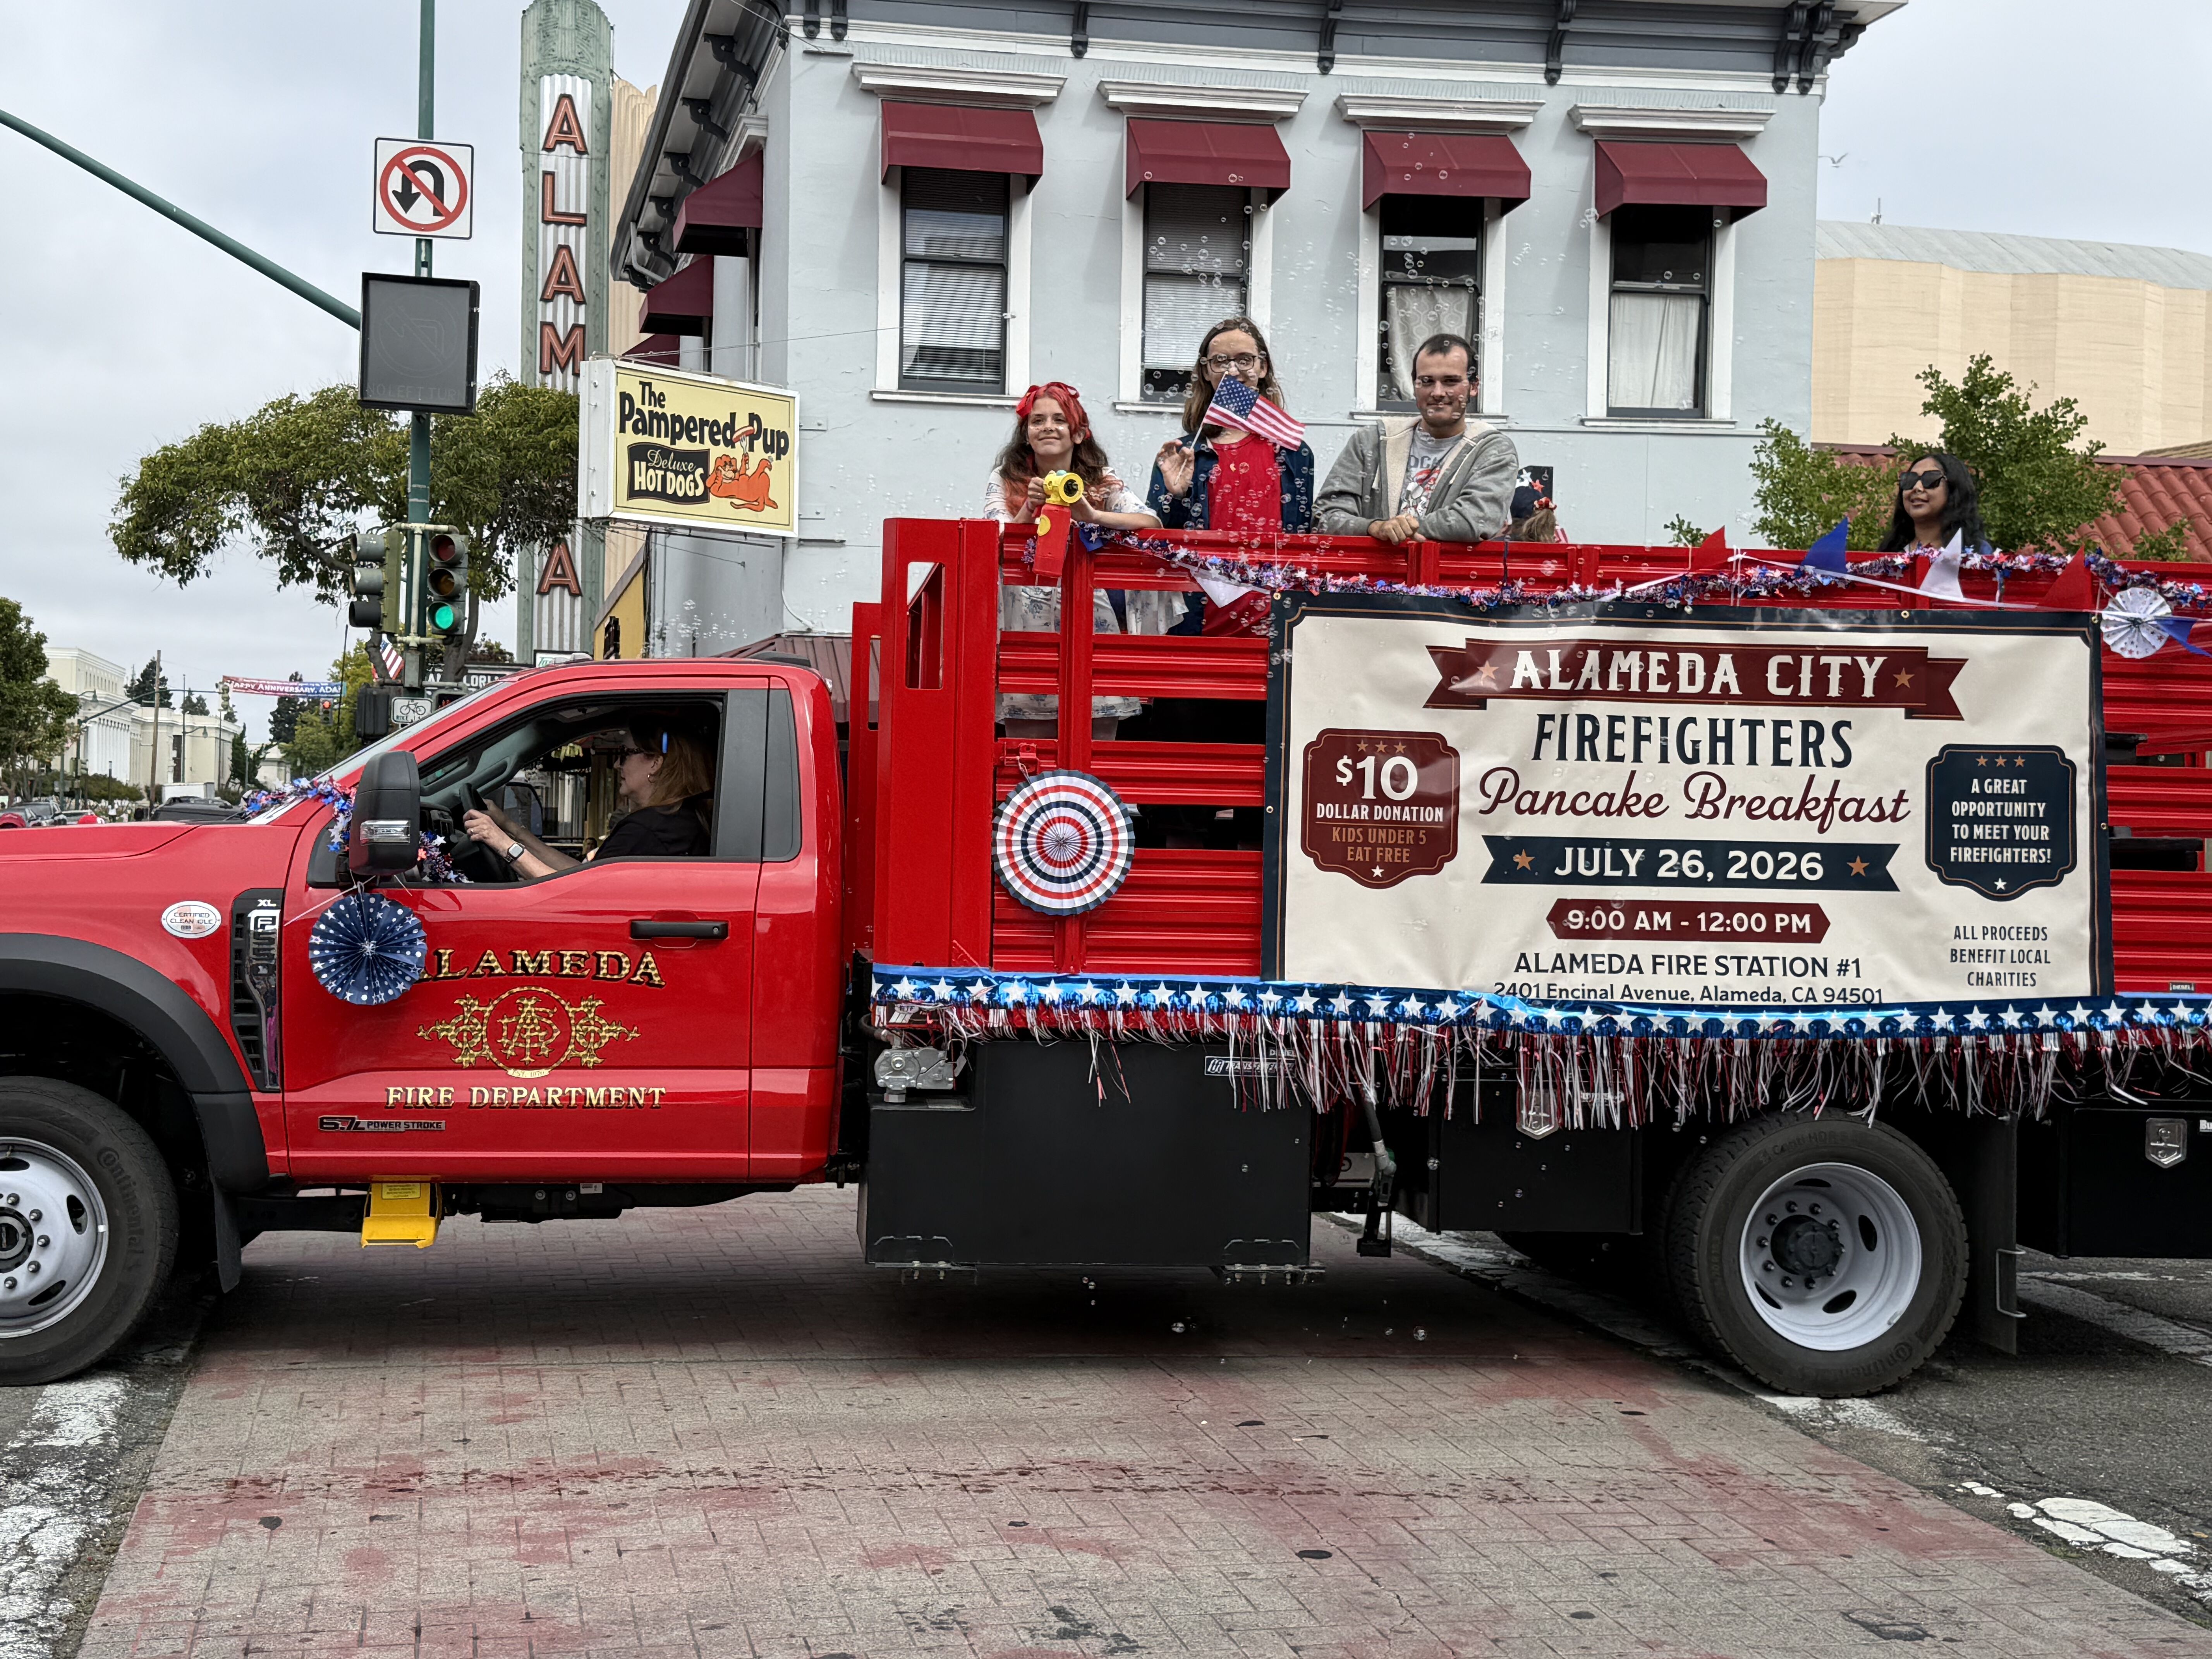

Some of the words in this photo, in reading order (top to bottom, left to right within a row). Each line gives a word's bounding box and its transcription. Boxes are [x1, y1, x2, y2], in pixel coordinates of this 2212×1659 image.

[639, 381, 666, 409] The
[619, 391, 736, 448] Pampered
[748, 412, 789, 461] Pup
[647, 449, 697, 473] Deluxe
[634, 461, 665, 492] HOT
[666, 467, 705, 497] DOGS
[1510, 649, 1742, 696] ALAMEDA
[1766, 655, 1889, 697] CITY
[1532, 713, 1853, 768] FIREFIGHTERS
[1336, 755, 1417, 800] $10
[1971, 778, 1980, 793] A
[1984, 779, 2027, 794] GREAT
[1478, 766, 1670, 818] Pancake
[1683, 770, 1911, 834] Breakfast
[1952, 801, 2046, 817] OPPORTUNITY
[1317, 803, 1369, 820] DOLLAR
[1374, 805, 1443, 822] DONATION
[1332, 827, 1363, 843] KIDS
[1368, 828, 1414, 844] UNDER
[1419, 830, 1426, 845] 5
[1952, 824, 1969, 839] TO
[1973, 824, 2009, 840] MEET
[2013, 825, 2049, 840] YOUR
[1347, 846, 1372, 861] EAT
[1376, 847, 1410, 863] FREE
[1554, 847, 1643, 878] JULY
[1657, 849, 1713, 882] 26,
[1726, 851, 1825, 881] 2026
[1950, 847, 2052, 864] FIREFIGHTERS!
[1568, 908, 1625, 930] 9:00
[1633, 911, 1672, 931] AM
[1697, 912, 1767, 933] 12:00
[1775, 914, 1812, 934] PM
[1954, 926, 1978, 939] ALL
[1982, 926, 2048, 941] PROCEEDS
[1514, 952, 1643, 975] ALAMEDA
[1652, 955, 1707, 976] FIRE
[1714, 956, 1828, 978] STATION
[1836, 958, 1862, 979] #1
[1950, 948, 2006, 963] BENEFIT
[2010, 949, 2051, 964] LOCAL
[1967, 972, 2037, 987] CHARITIES
[1494, 982, 1540, 999] 2401
[1547, 983, 1614, 1000] Encinal
[1620, 984, 1694, 1002] Avenue,
[1700, 985, 1786, 1004] Alameda,
[1791, 987, 1818, 1003] CA
[1823, 988, 1882, 1004] 94501
[385, 1087, 455, 1109] FIRE
[468, 1087, 666, 1109] DEPARTMENT
